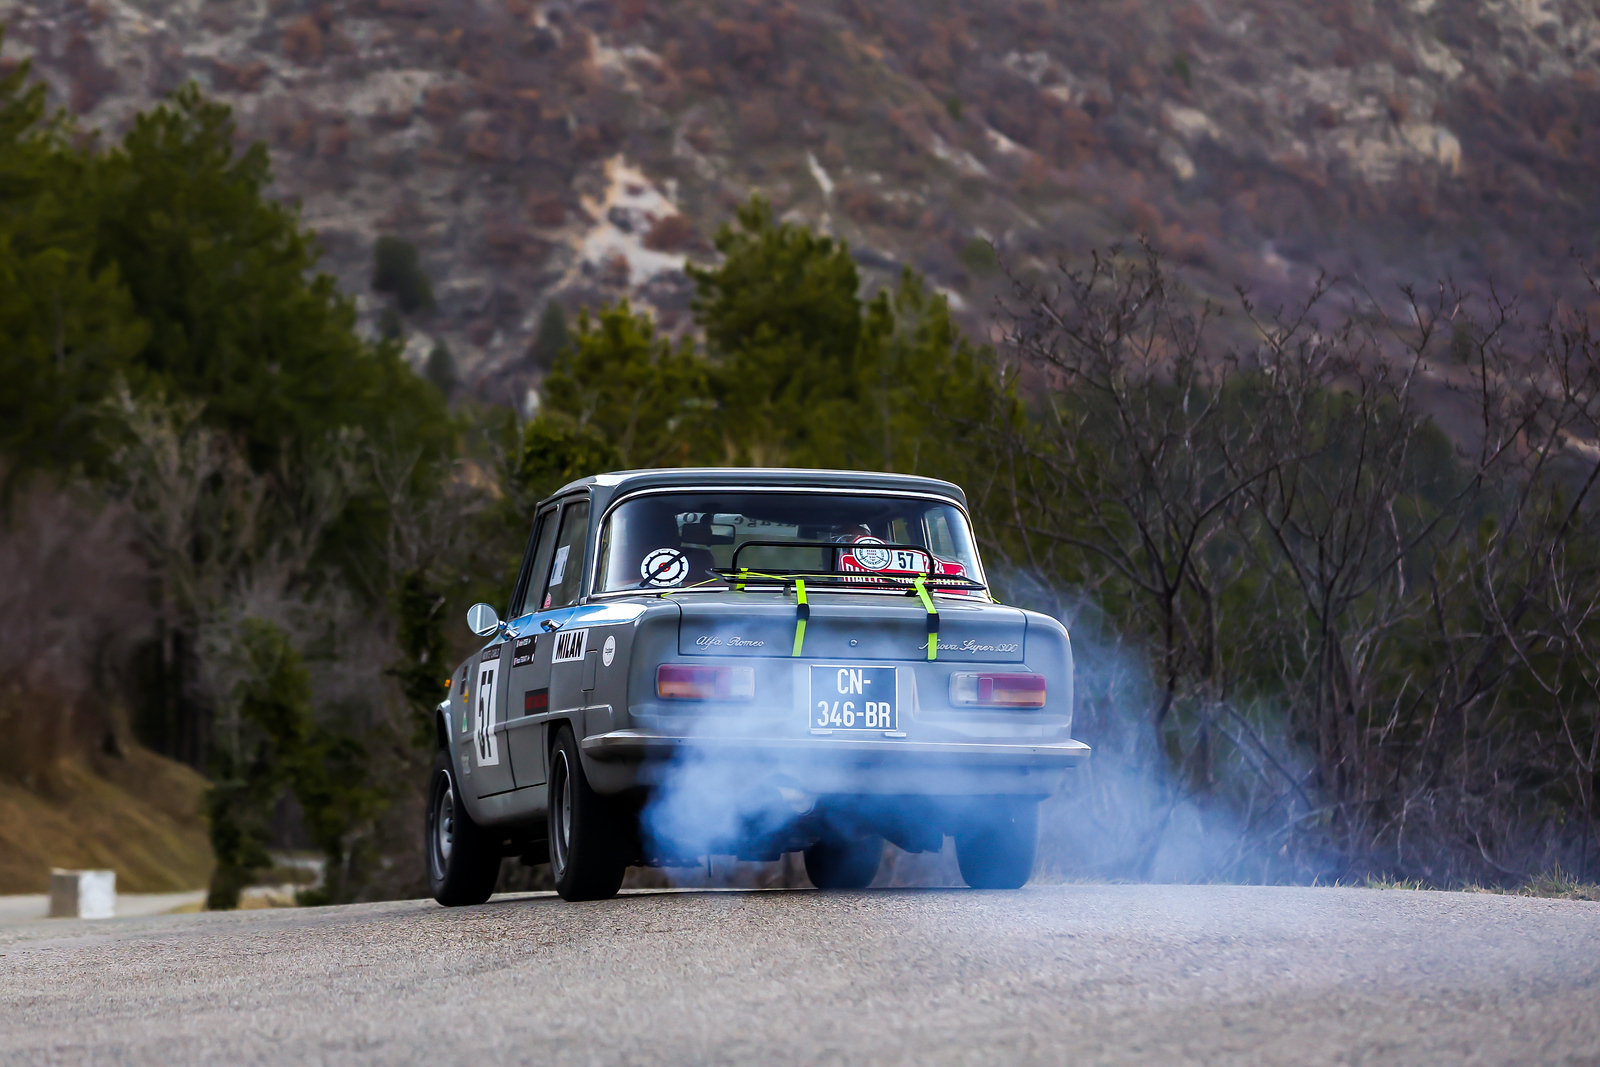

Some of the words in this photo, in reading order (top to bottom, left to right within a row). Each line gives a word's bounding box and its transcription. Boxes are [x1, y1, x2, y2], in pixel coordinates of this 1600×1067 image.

[897, 551, 914, 569] 57
[923, 556, 945, 574] 224
[555, 631, 584, 660] MILAN
[695, 635, 723, 650] Alfa
[726, 636, 765, 647] Romeo
[959, 639, 994, 654] Super
[837, 668, 871, 694] CN-
[476, 669, 494, 760] 57
[817, 700, 891, 728] 346-BR
